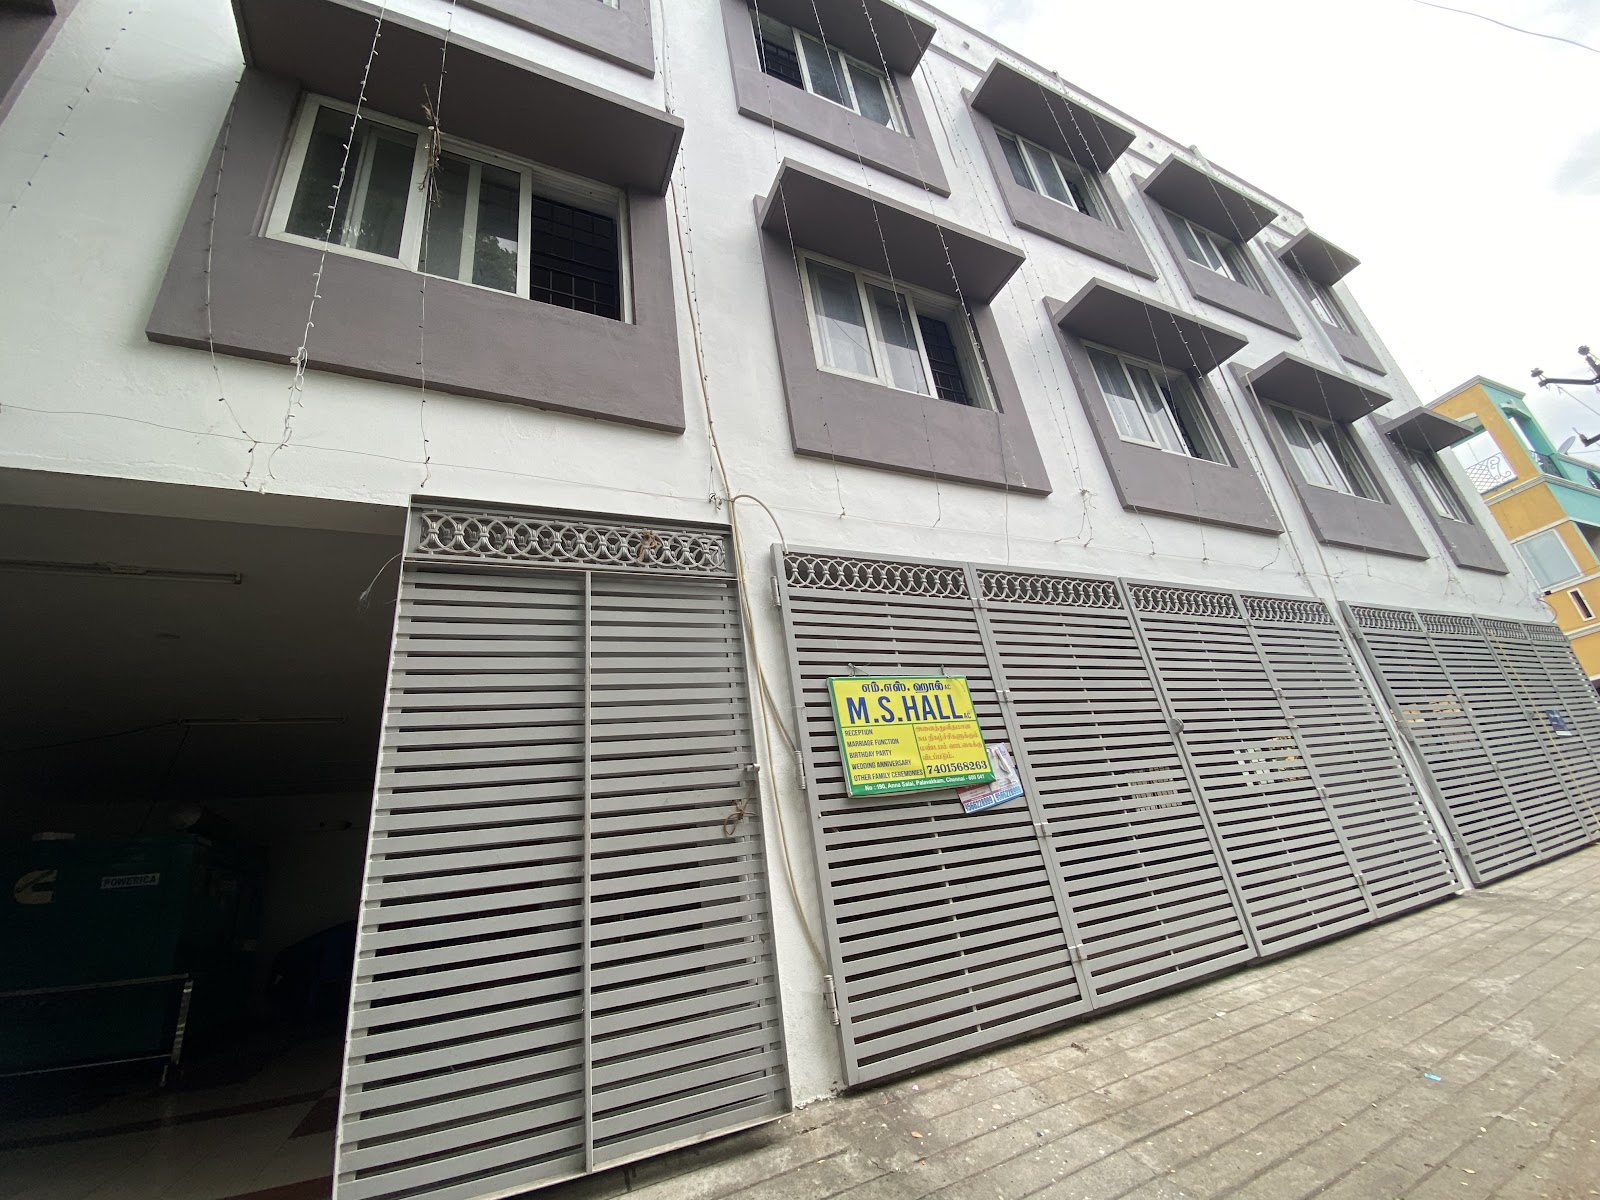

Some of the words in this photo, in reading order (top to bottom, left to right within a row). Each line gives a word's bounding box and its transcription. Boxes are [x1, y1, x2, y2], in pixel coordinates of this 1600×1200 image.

[846, 694, 963, 724] M.S.HALL
[846, 739, 874, 747] MARRIAGE
[875, 738, 899, 746] FUNCTION
[849, 751, 875, 759] BIRTHDAY
[851, 762, 876, 770] WEDDING
[877, 759, 912, 768] ANNIVERSARY
[926, 760, 988, 775] 7401568263
[853, 773, 871, 782] OTHER
[873, 771, 891, 780] FAMILY
[891, 769, 924, 778] CEREMONIES
[103, 875, 156, 888] POWERICA
